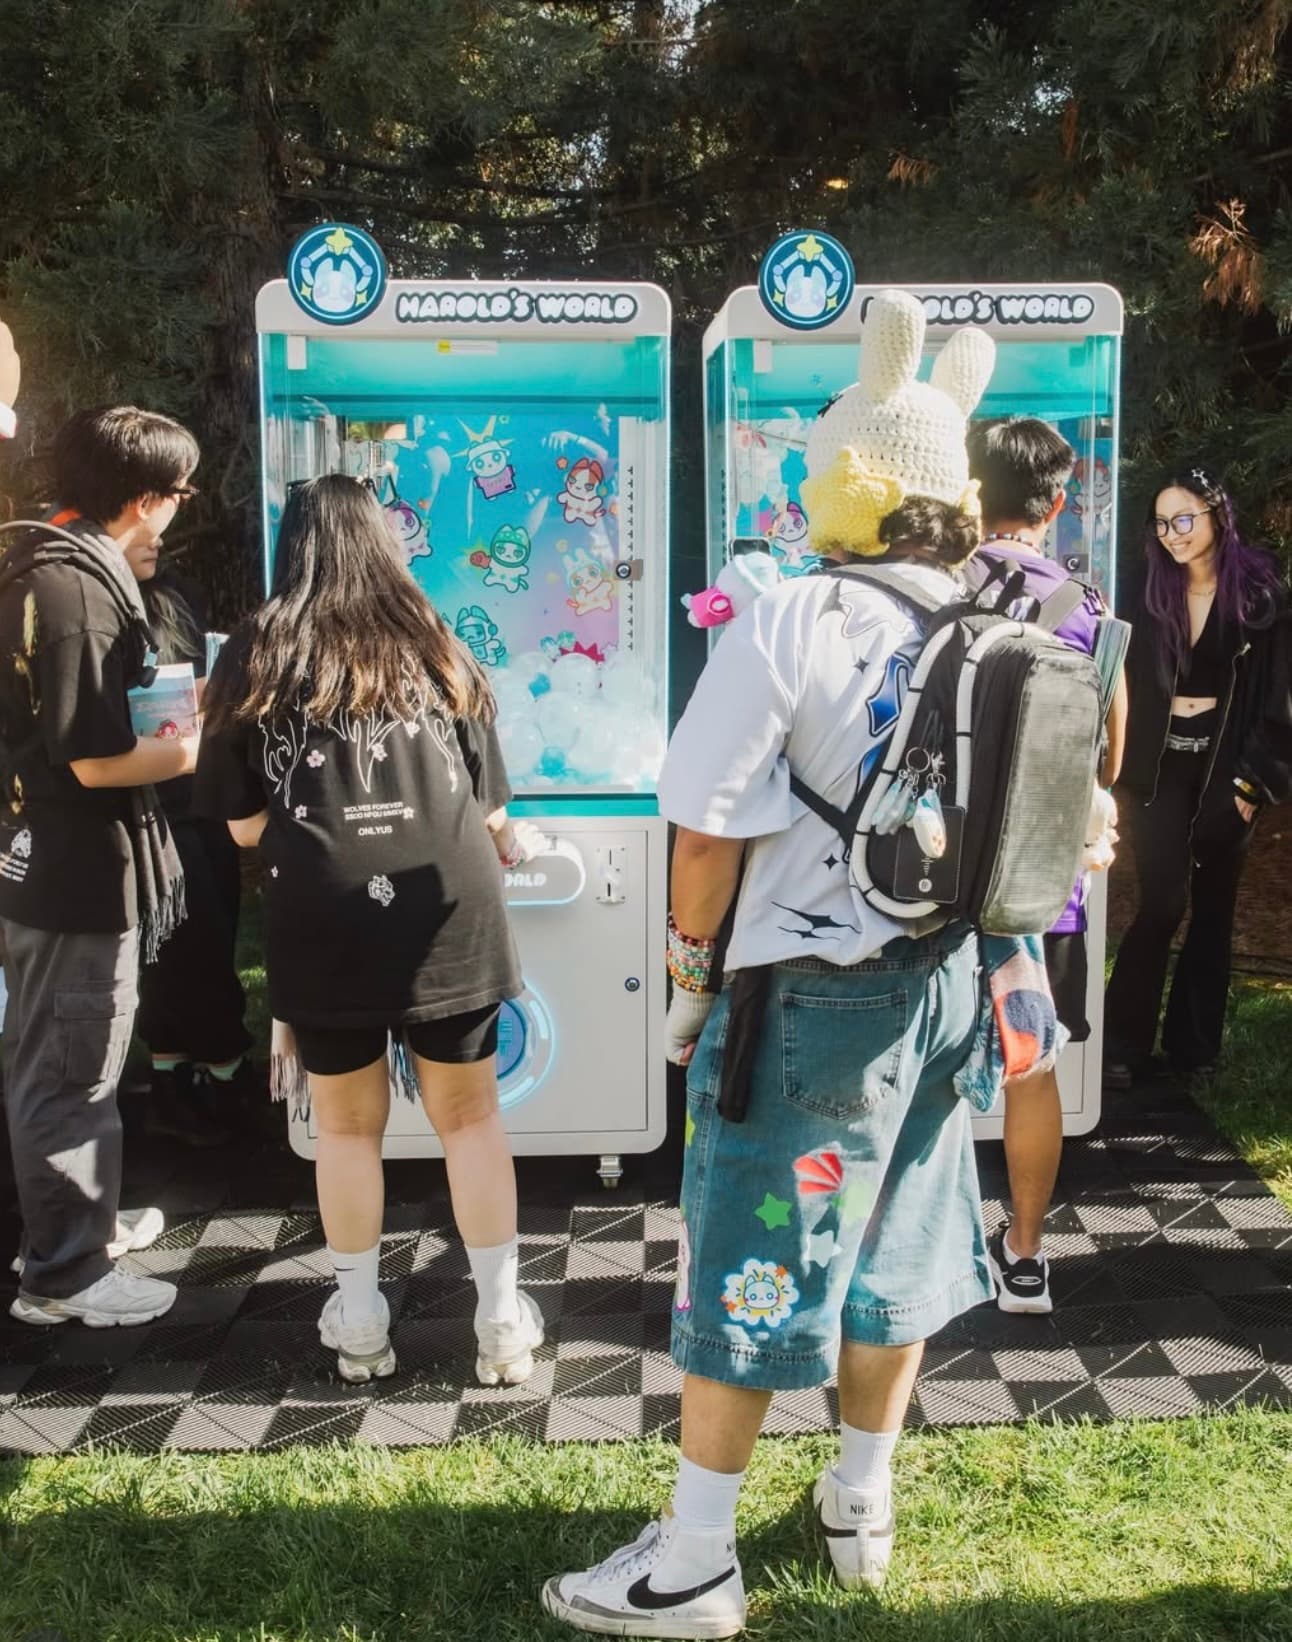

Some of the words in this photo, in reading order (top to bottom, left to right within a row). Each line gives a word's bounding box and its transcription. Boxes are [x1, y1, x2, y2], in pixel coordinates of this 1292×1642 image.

[397, 288, 534, 323] HAROLD'S
[536, 293, 638, 323] WORLD
[996, 294, 1094, 324] WORLD
[372, 801, 404, 811] FOREVER
[504, 873, 547, 888] ORLD
[850, 1504, 873, 1514] NIKE
